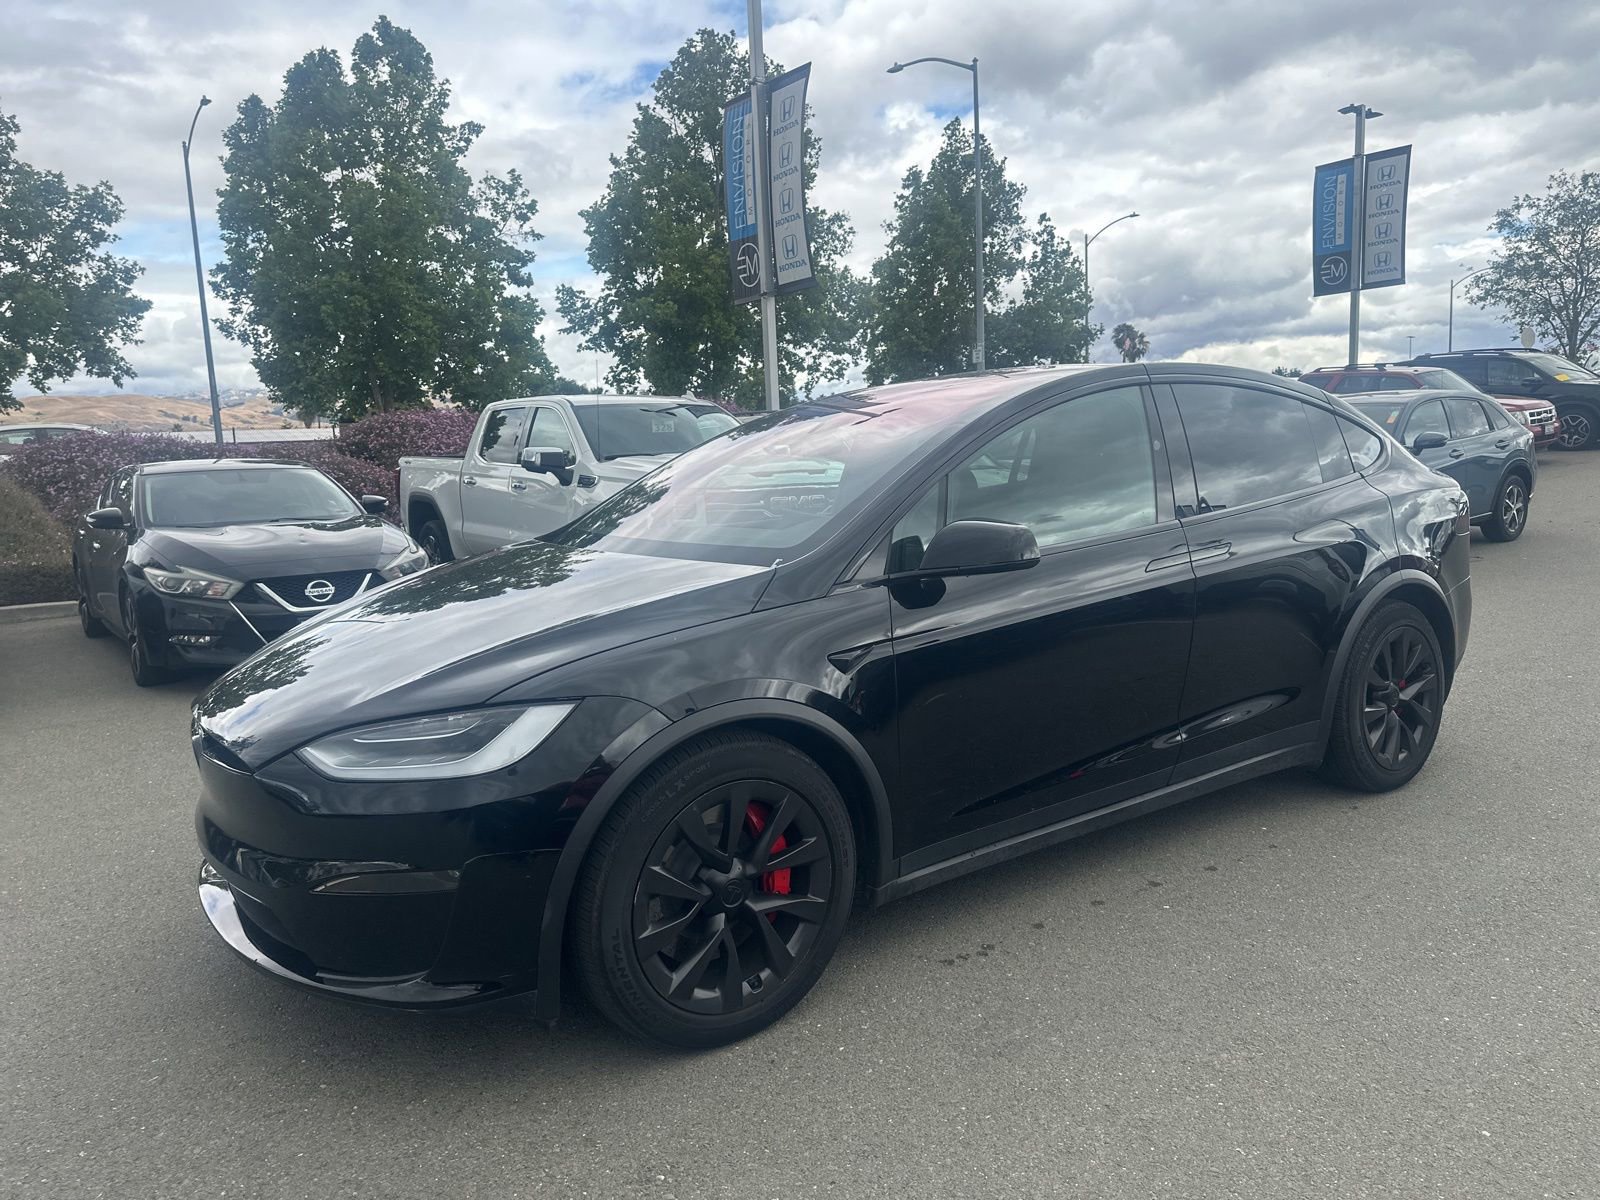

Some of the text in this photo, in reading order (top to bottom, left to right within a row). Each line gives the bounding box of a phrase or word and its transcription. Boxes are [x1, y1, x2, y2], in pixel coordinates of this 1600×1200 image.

[773, 119, 799, 137] HONDA
[732, 116, 747, 229] ENVISION
[773, 165, 799, 182] HONDA
[1369, 180, 1402, 190] HONDA
[1322, 175, 1337, 248] ENVISION
[1368, 208, 1400, 219] HONDA
[774, 212, 801, 228] HONDA
[1367, 237, 1399, 248] HONDA
[778, 258, 808, 273] HONDA
[1367, 266, 1399, 276] HONDA
[307, 587, 333, 595] NISSAN
[665, 778, 687, 798] LX
